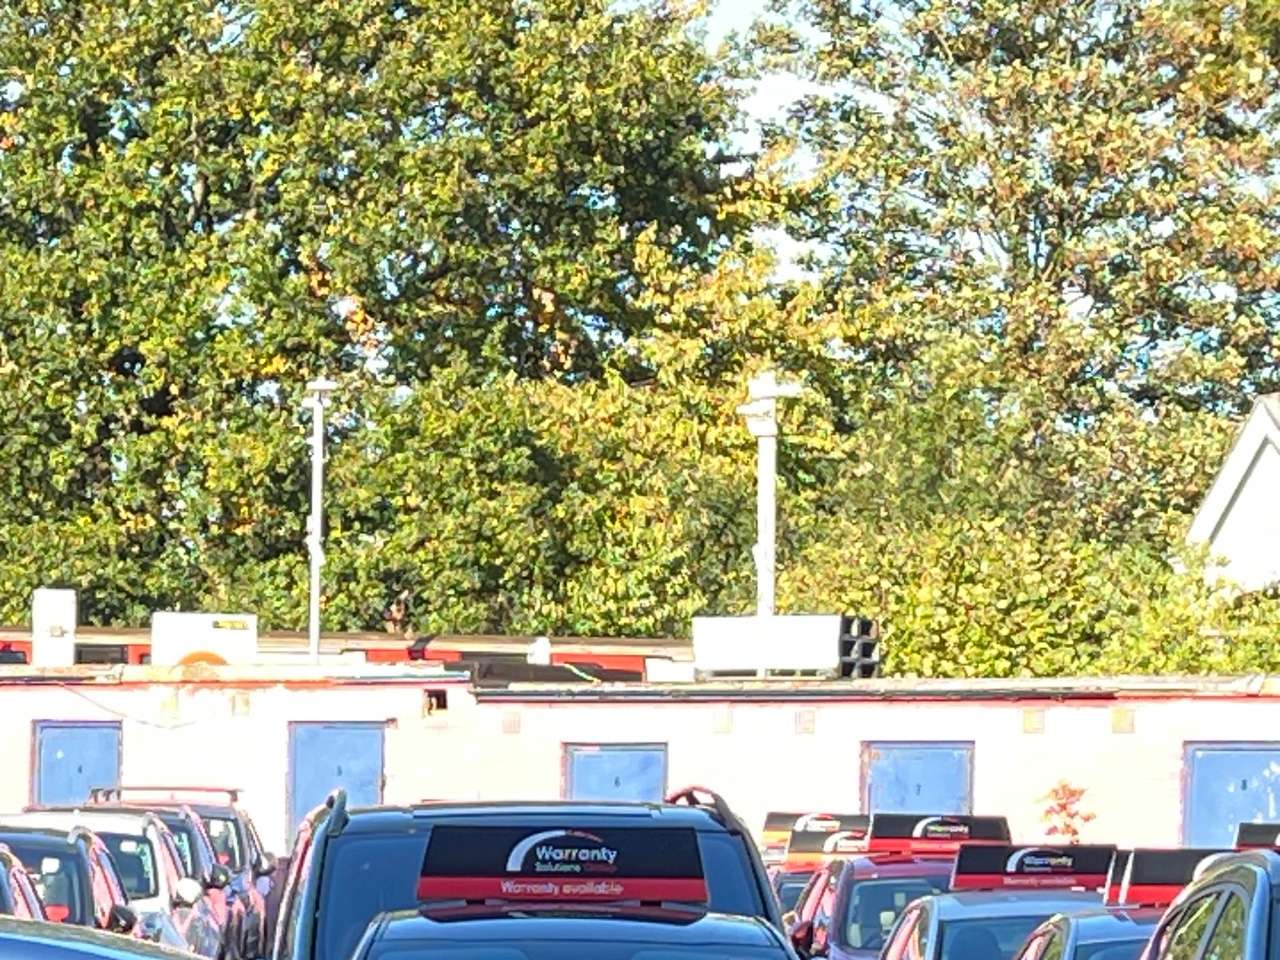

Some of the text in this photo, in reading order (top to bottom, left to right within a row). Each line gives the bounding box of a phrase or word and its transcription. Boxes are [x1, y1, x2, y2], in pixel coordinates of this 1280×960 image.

[535, 845, 618, 864] Warranty
[500, 880, 624, 896] Warranty available
